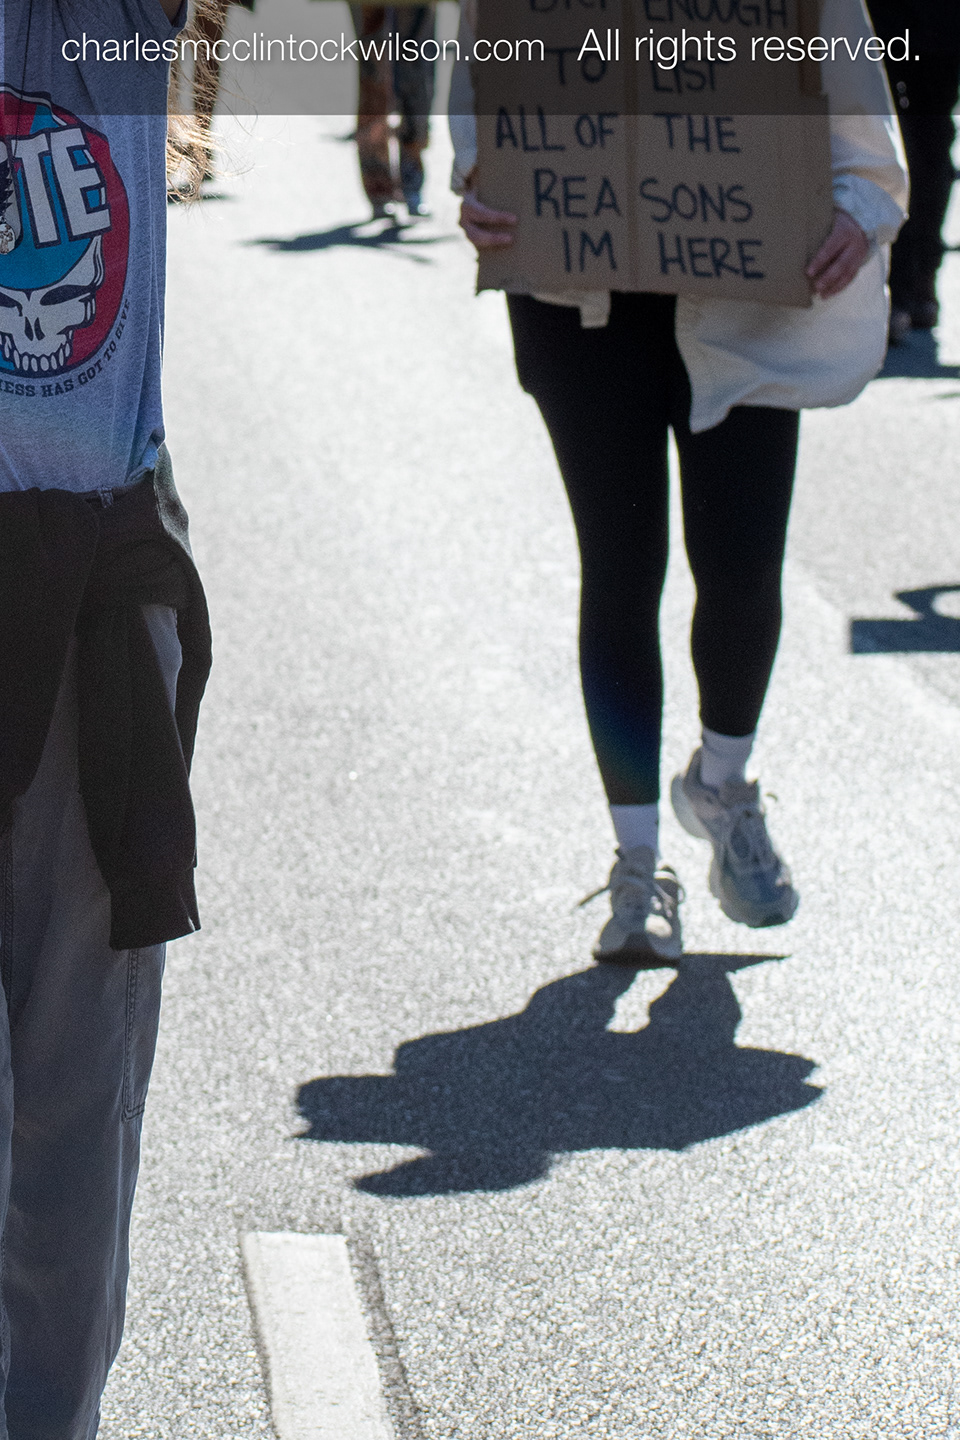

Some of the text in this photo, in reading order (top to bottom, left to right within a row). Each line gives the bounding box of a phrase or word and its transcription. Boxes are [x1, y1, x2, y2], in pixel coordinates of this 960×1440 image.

[543, 46, 607, 87] TO
[495, 104, 741, 154] ALL OF THE
[562, 229, 766, 280] IM HERE
[40, 377, 75, 398] HAS
[77, 359, 104, 386] GOT
[104, 339, 118, 362] TO
